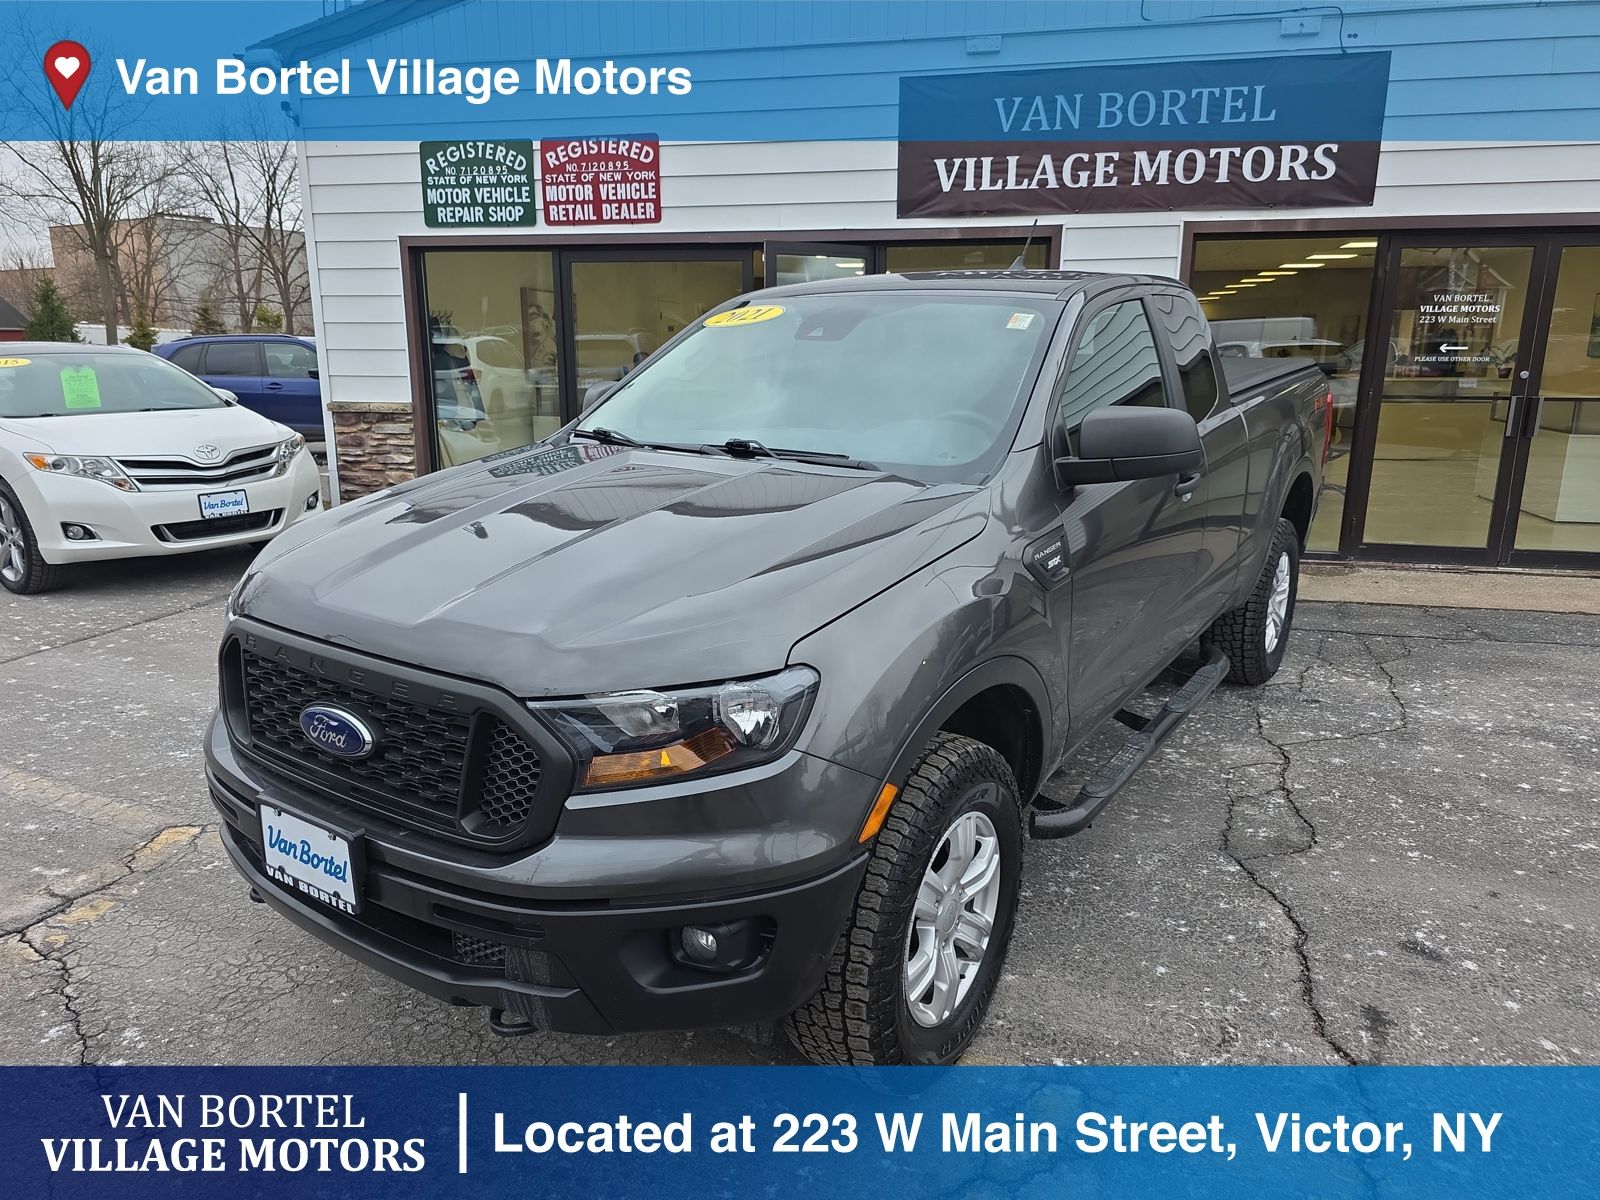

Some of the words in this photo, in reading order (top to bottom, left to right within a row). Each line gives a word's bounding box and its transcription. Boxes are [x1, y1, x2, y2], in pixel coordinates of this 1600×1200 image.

[994, 93, 1084, 132] VAN
[1097, 85, 1277, 129] BORTEL
[425, 141, 527, 175] REGISTERED
[544, 138, 655, 169] REGISTERED
[445, 167, 458, 175] NO.
[460, 166, 508, 175] 7120895
[565, 163, 579, 172] NO.
[580, 161, 630, 172] 7120895
[933, 151, 1119, 193] VILLAGE
[1130, 143, 1339, 187] MOTORS
[427, 176, 456, 185] STATE
[459, 175, 473, 185] OF
[475, 175, 497, 184] NEW
[500, 175, 528, 184] YORK
[545, 173, 577, 183] STATE
[581, 173, 594, 182] OF
[599, 172, 622, 182] NEW
[625, 171, 656, 181] YORK
[426, 187, 474, 205] MOTOR
[477, 186, 531, 204] VEHICLE
[545, 184, 593, 202] MOTOR
[599, 183, 657, 200] VEHICLE
[437, 206, 484, 223] REPAIR
[488, 205, 524, 222] SHOP
[549, 204, 597, 222] RETAIL
[602, 202, 655, 220] DEALER
[1433, 294, 1453, 302] VAN
[1454, 294, 1490, 302] BORTEL
[714, 307, 775, 324] 2021
[1420, 305, 1458, 313] VILLAGE
[1460, 305, 1501, 313] MOTORS
[1419, 316, 1436, 324] 223
[1471, 316, 1497, 324] Street
[203, 500, 220, 510] Van
[220, 498, 244, 508] Bortel
[1034, 541, 1062, 560] RANGER
[1048, 555, 1062, 569] STX
[245, 634, 459, 711] RANGER
[309, 714, 348, 749] Ford
[268, 825, 298, 860] Van
[299, 839, 348, 883] Bortel
[266, 864, 294, 887] VAN
[298, 880, 356, 915] BORTEL
